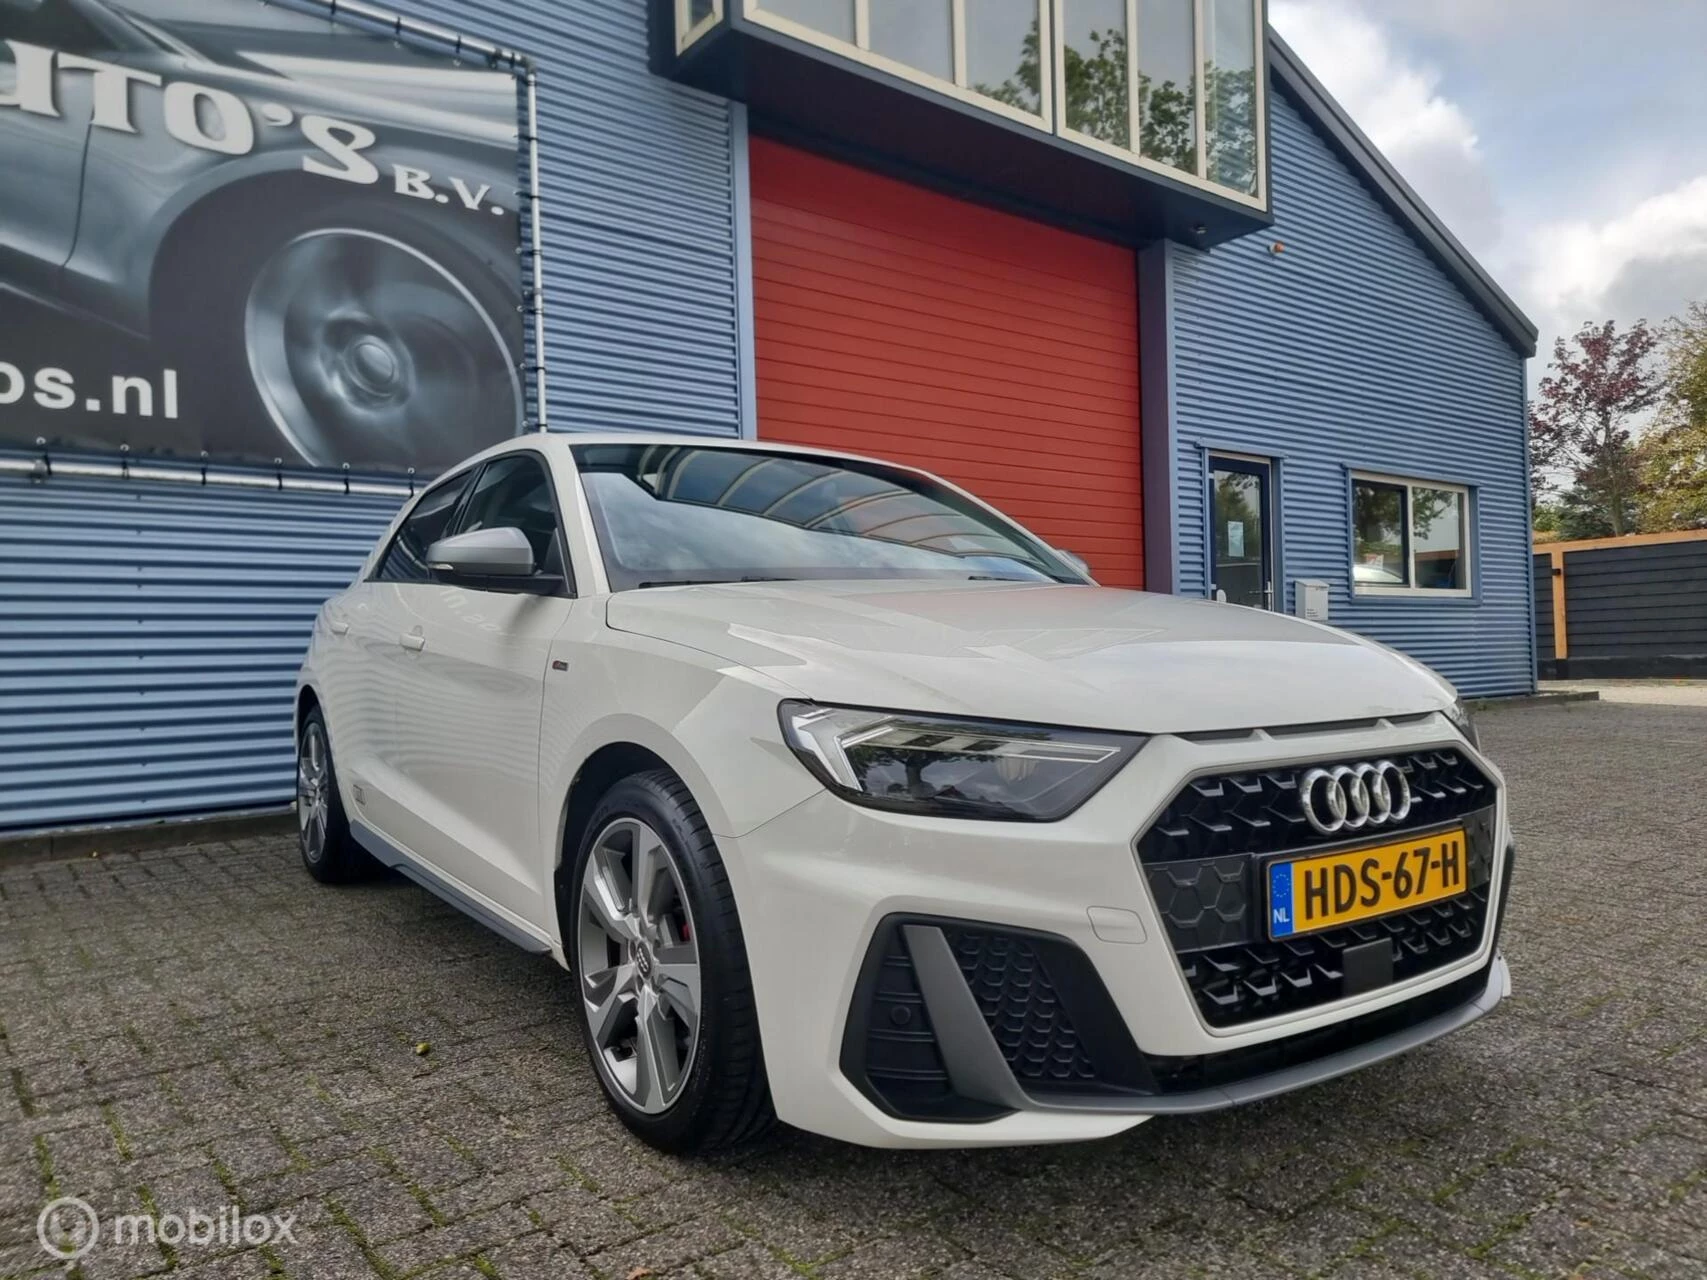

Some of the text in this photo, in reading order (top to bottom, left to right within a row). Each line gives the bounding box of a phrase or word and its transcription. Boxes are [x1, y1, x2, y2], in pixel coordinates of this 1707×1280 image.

[391, 163, 505, 216] B.V.
[1304, 840, 1461, 921] HDS-67-H
[1272, 906, 1291, 925] NL
